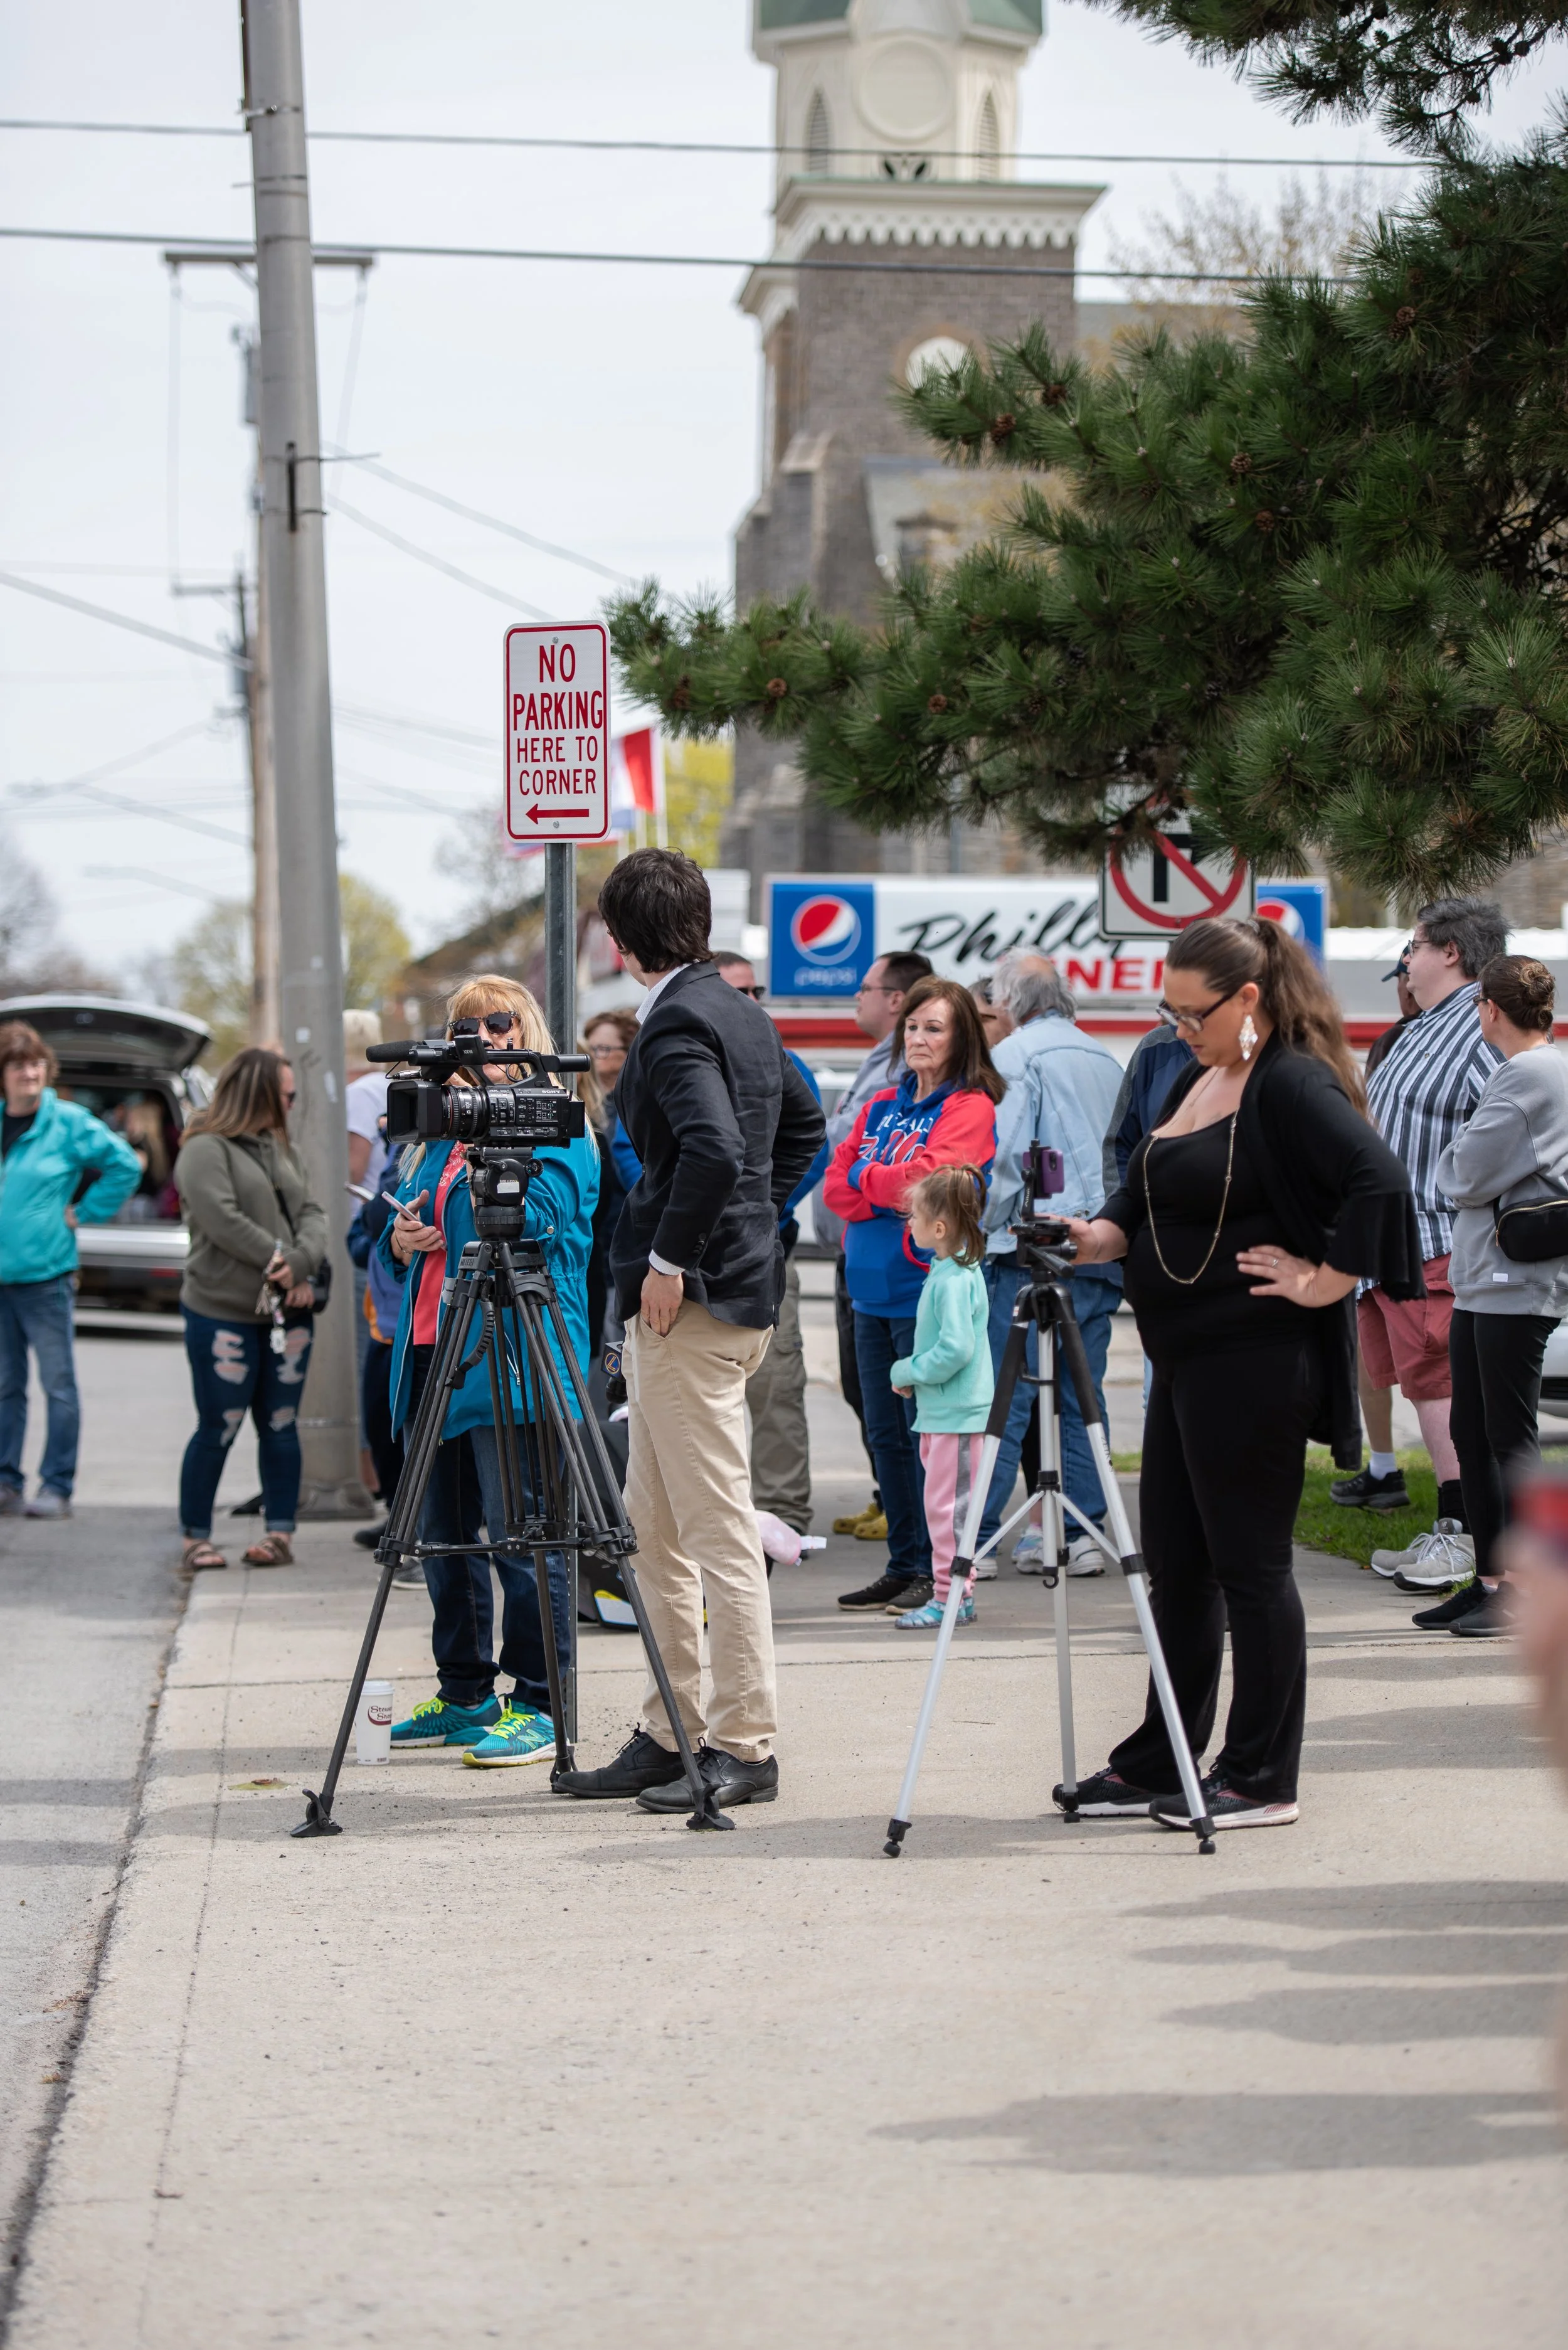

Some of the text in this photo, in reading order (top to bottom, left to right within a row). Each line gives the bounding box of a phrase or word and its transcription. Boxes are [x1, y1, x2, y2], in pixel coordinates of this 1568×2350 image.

[539, 643, 576, 683] NO
[513, 690, 603, 731] PARKING
[517, 735, 598, 763] HERE TO
[519, 768, 596, 795] CORNER
[898, 899, 1123, 962] Phill
